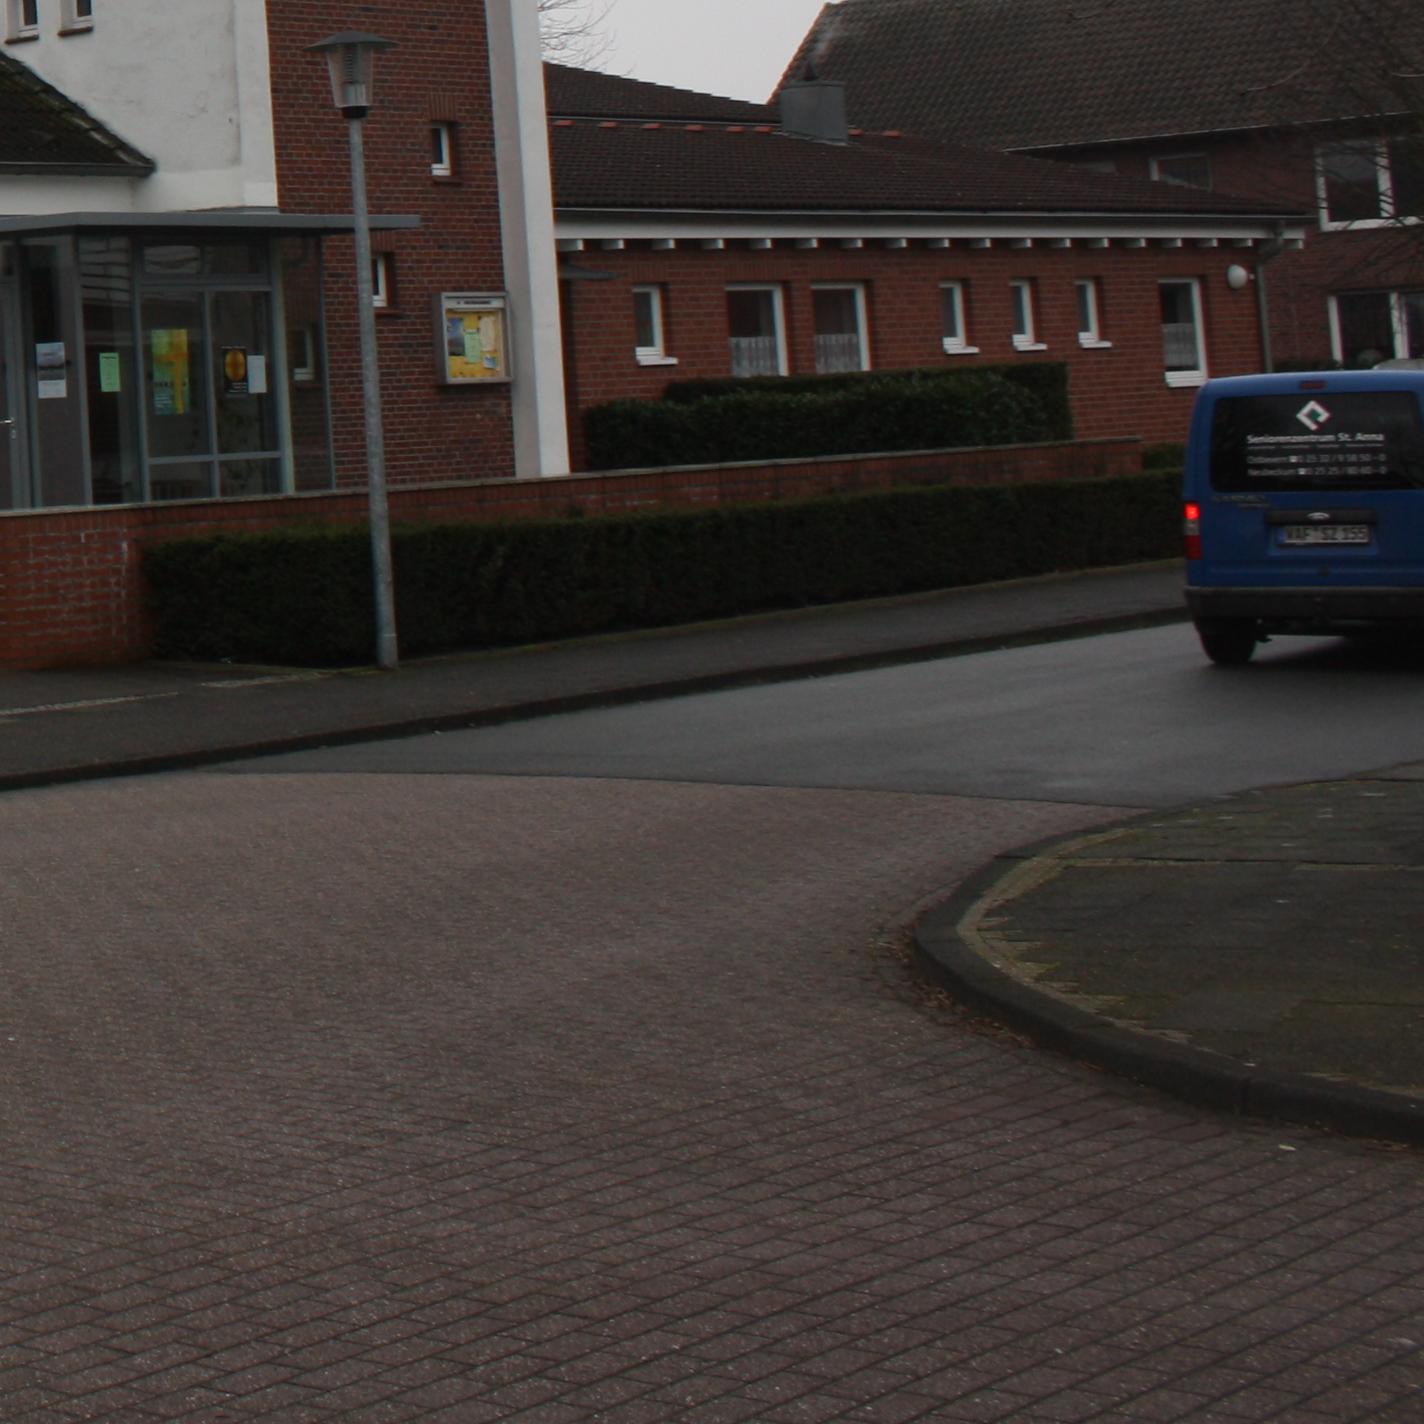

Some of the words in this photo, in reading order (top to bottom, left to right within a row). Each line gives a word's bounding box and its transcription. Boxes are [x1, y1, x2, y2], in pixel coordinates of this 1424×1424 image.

[1246, 433, 1336, 444] Seniorenzentrum
[1337, 432, 1352, 442] St.
[1354, 432, 1385, 442] Anna
